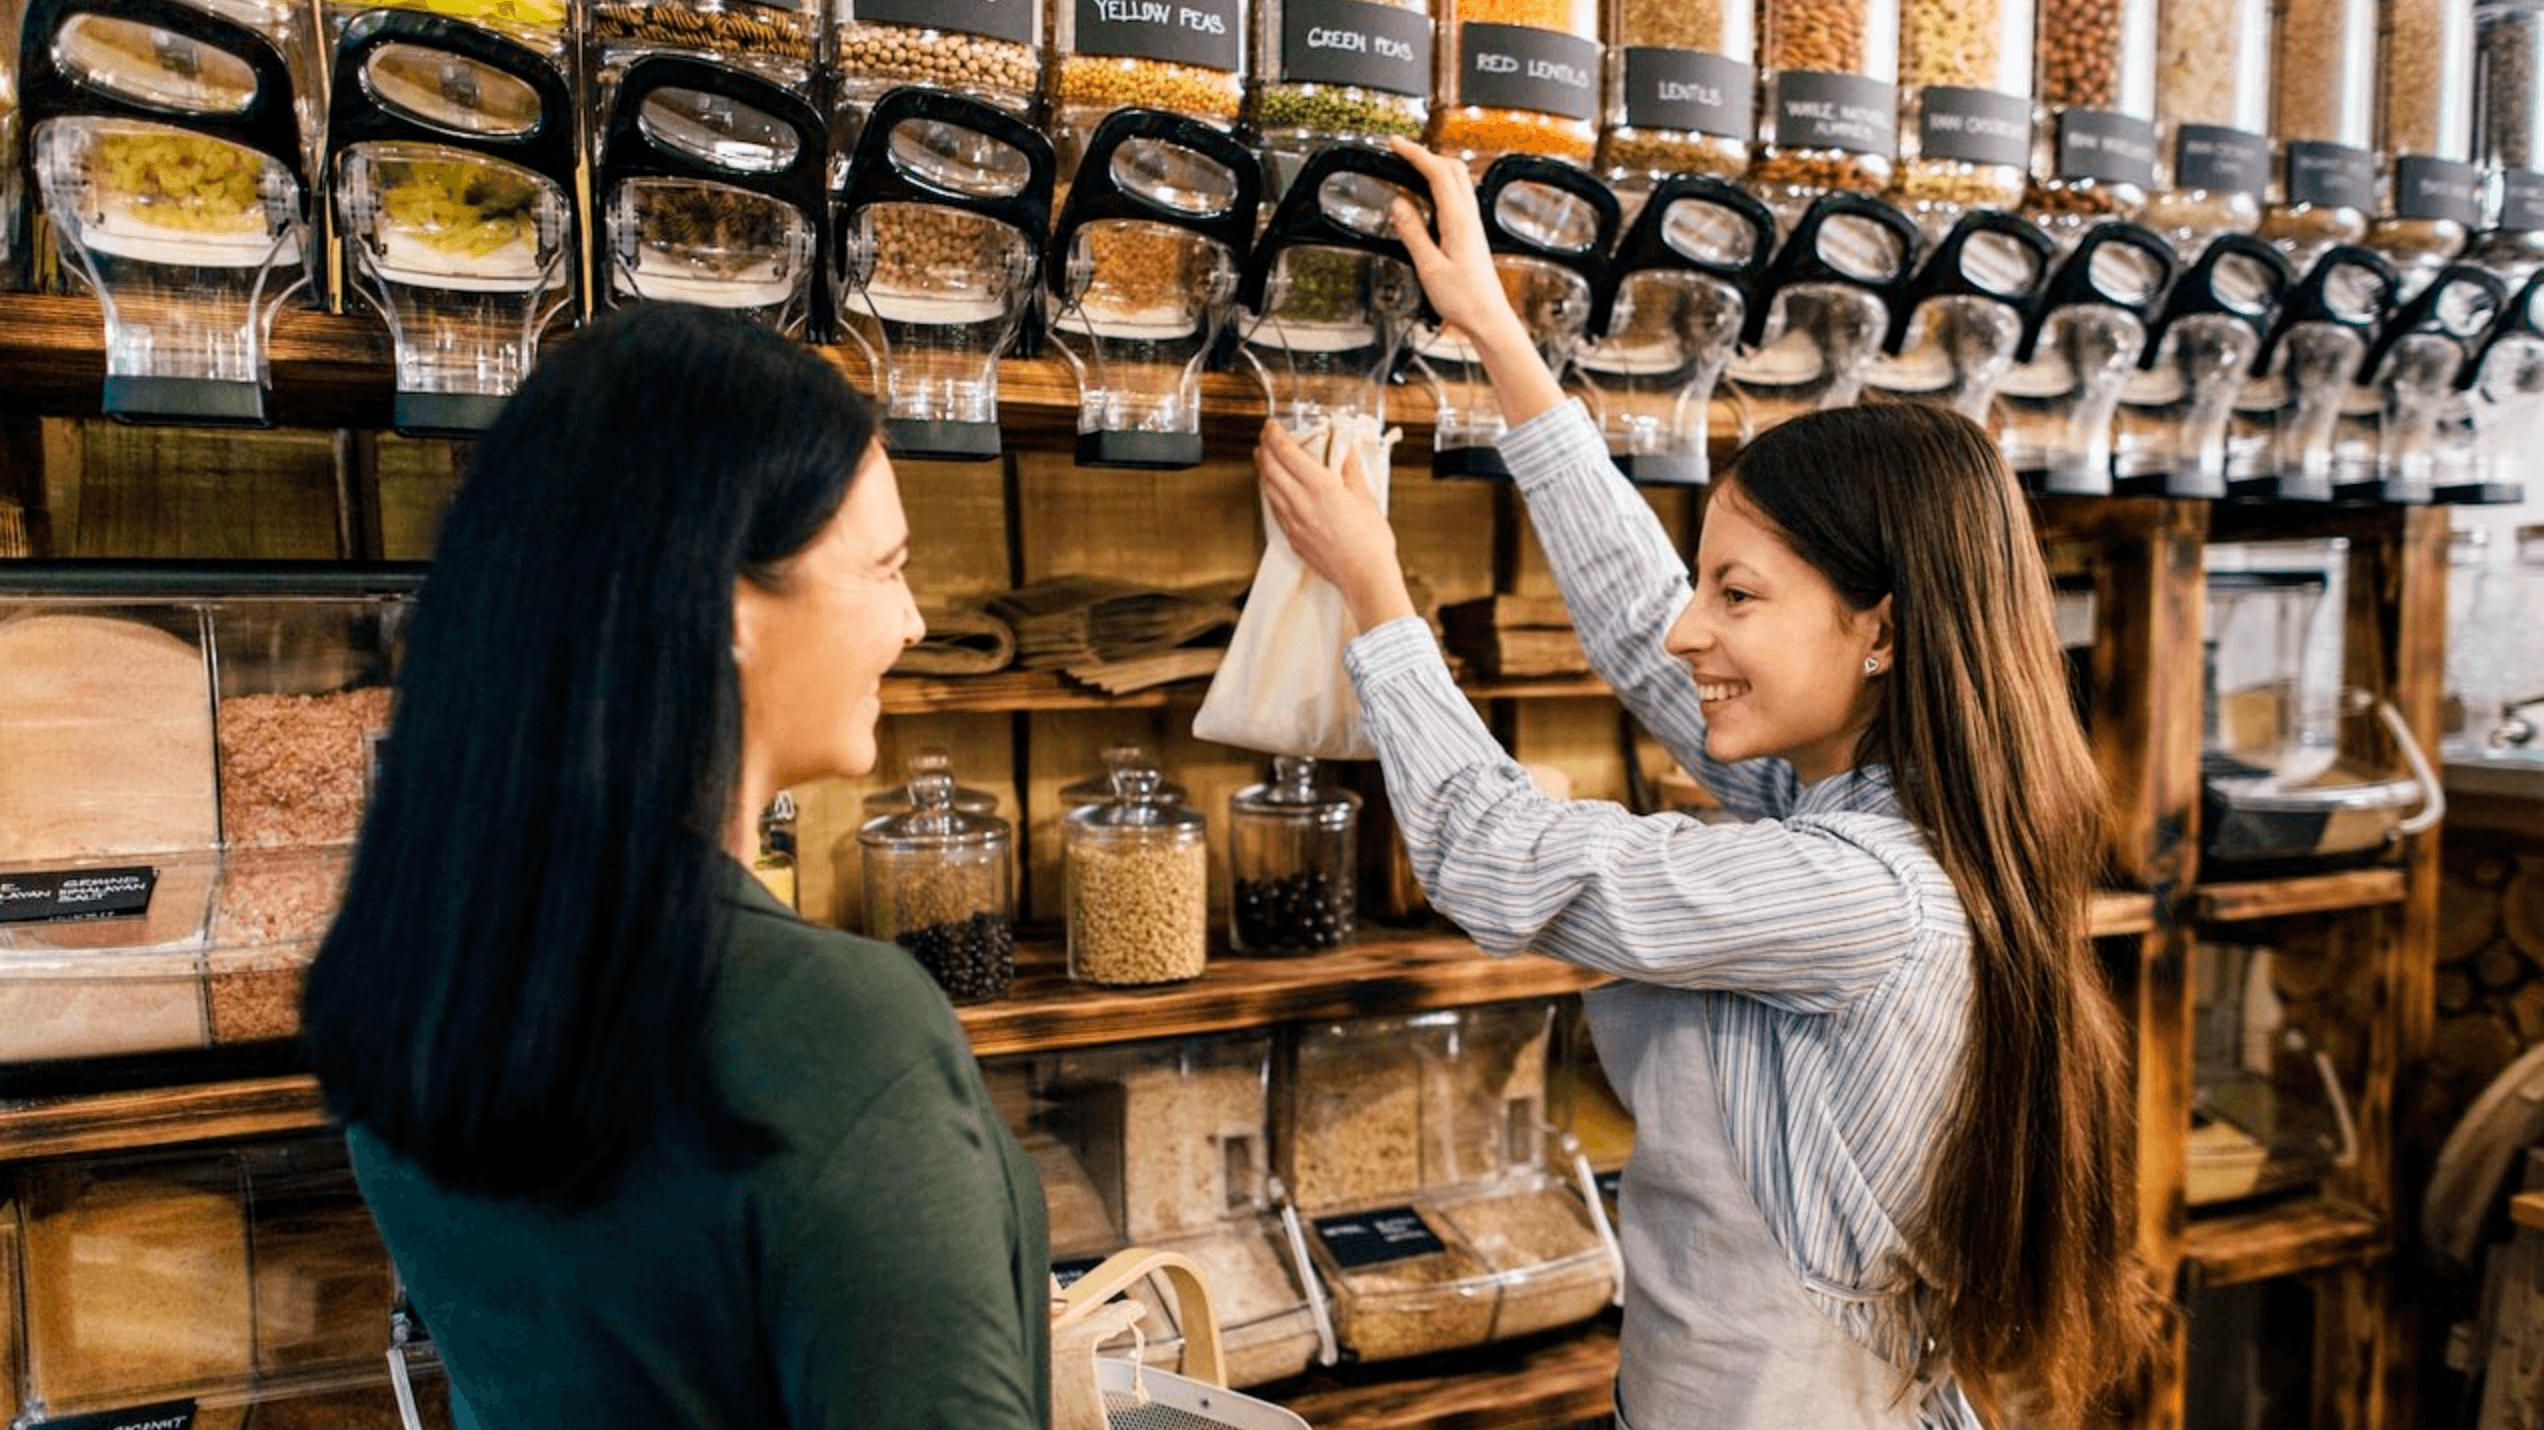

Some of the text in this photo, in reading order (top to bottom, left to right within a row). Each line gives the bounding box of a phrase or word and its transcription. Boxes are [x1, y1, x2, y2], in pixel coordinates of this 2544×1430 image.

[1094, 0, 1226, 34] YELLOW PEAS
[1307, 27, 1414, 61] GREEN PEAS
[1476, 53, 1590, 89] RED LENTILS
